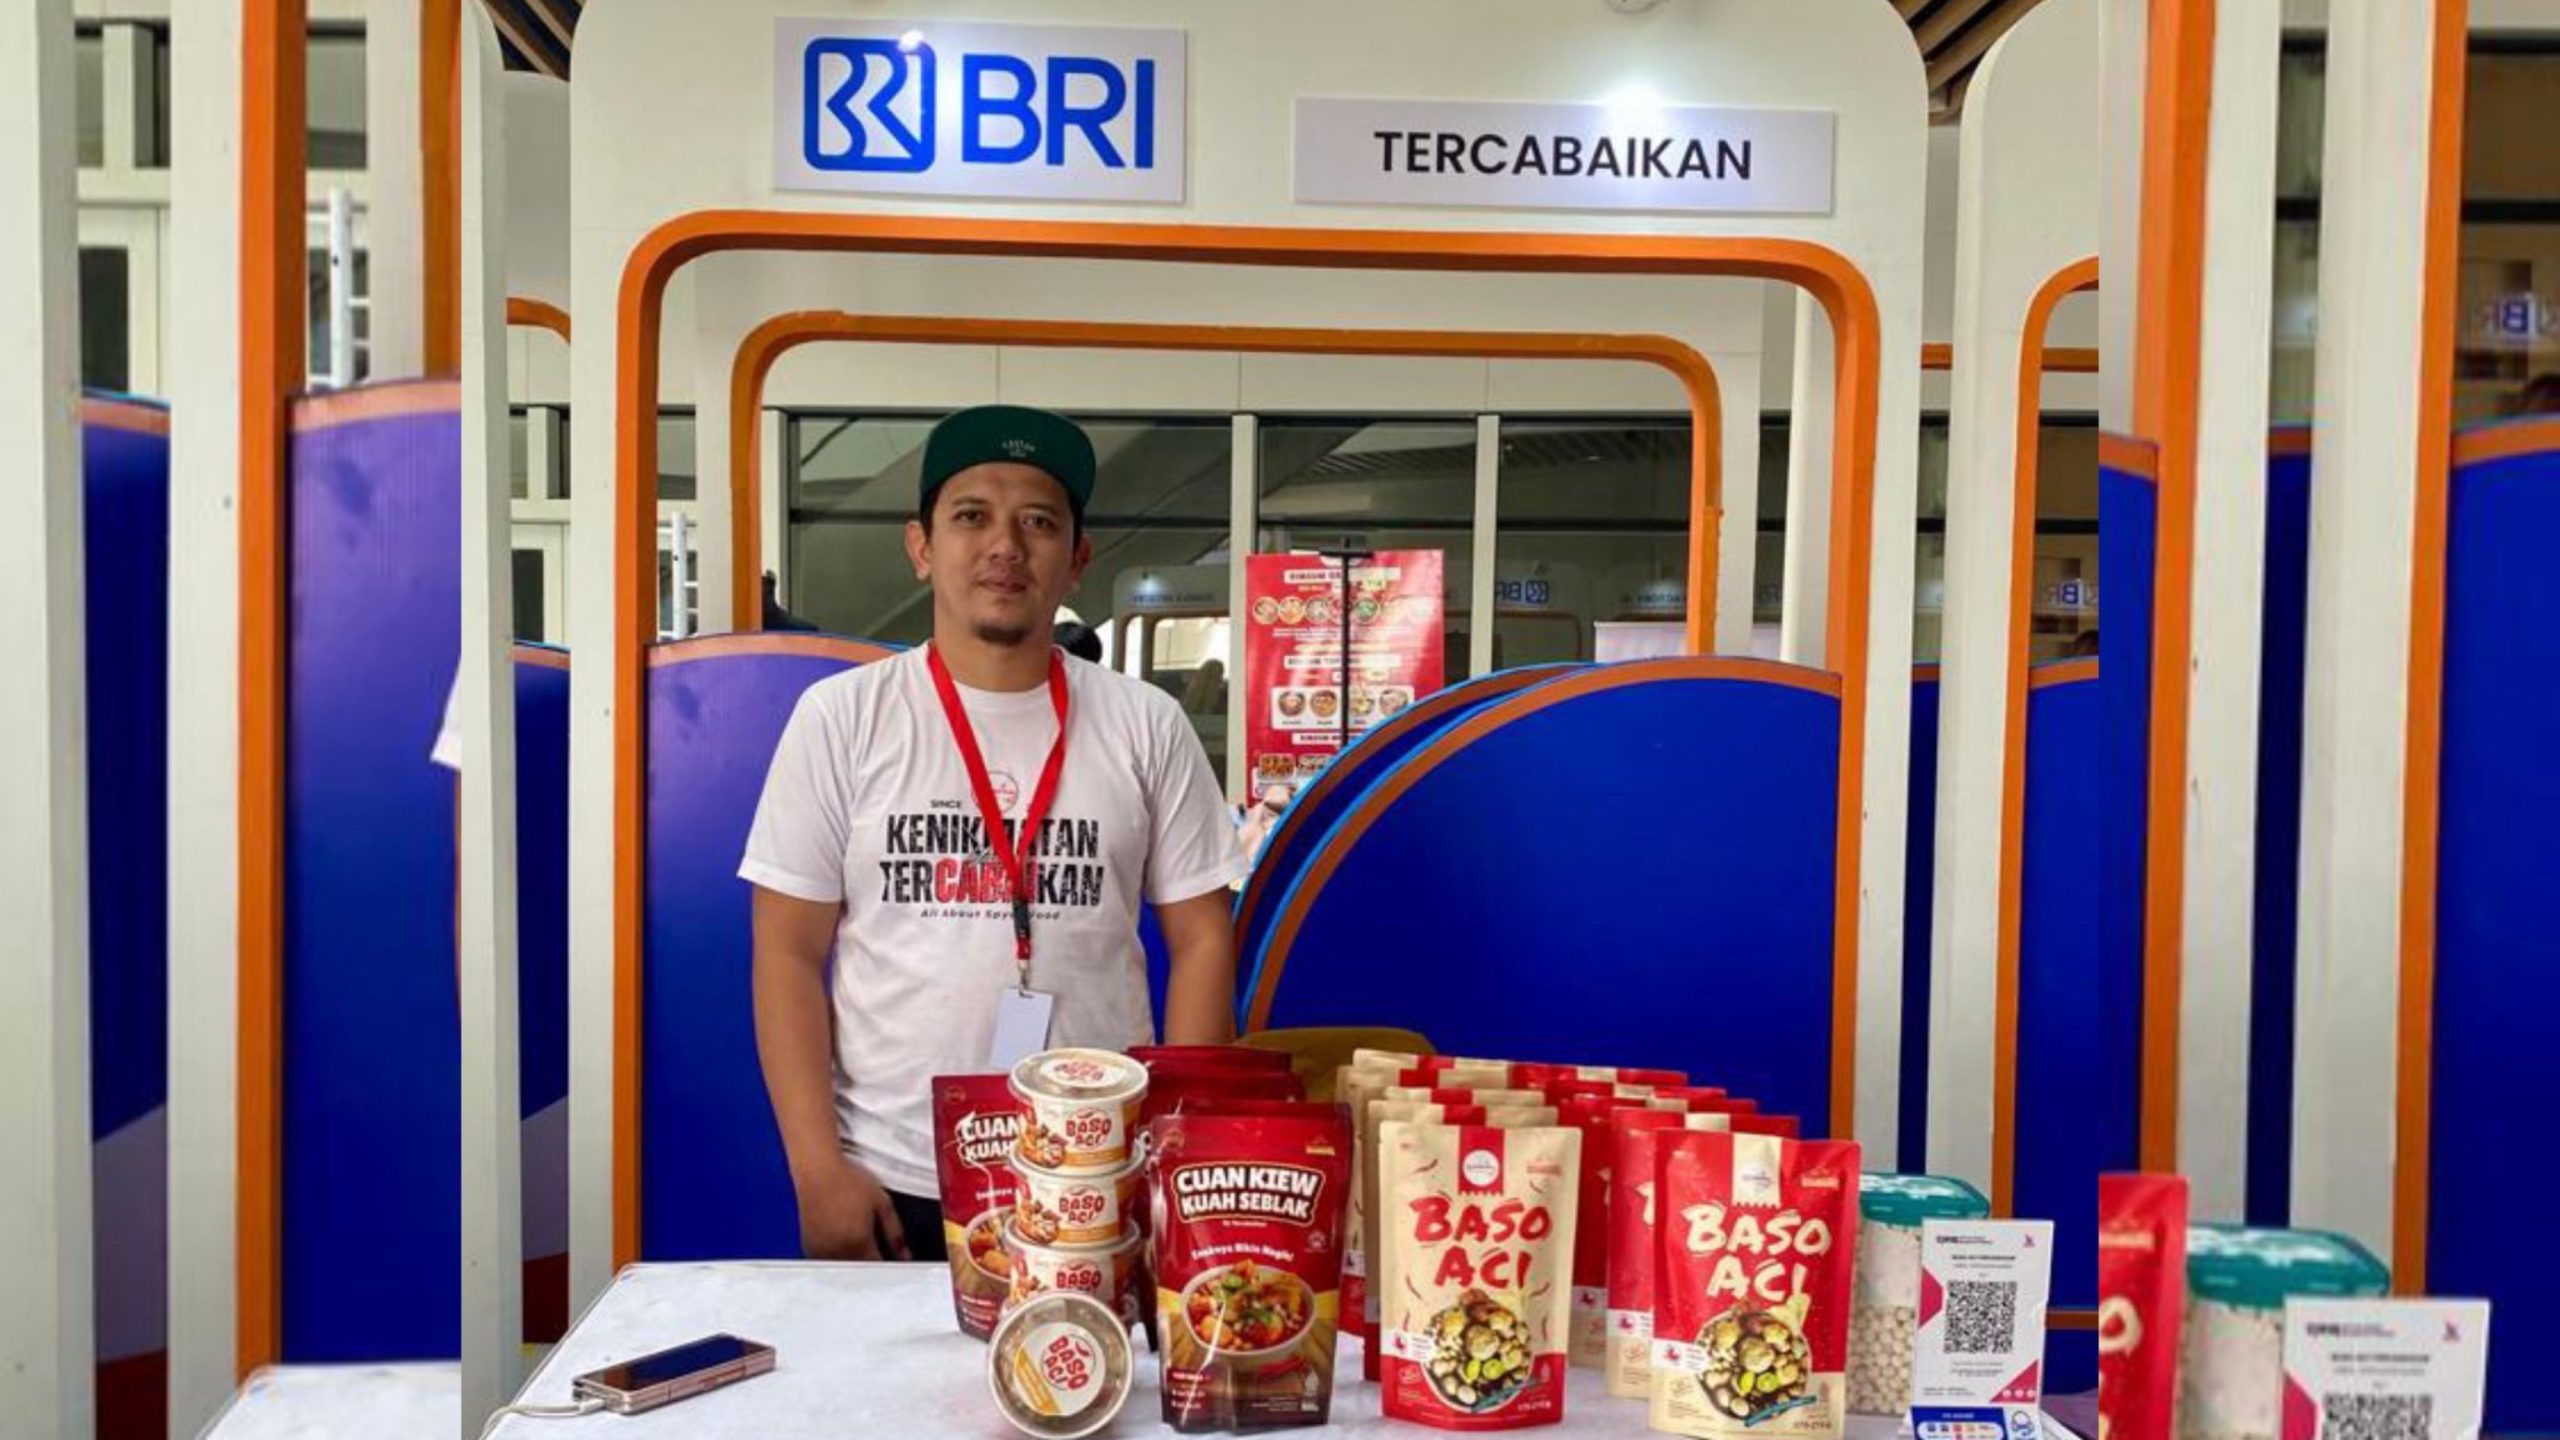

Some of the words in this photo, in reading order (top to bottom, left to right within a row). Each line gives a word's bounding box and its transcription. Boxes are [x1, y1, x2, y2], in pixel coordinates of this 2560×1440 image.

[962, 53, 1156, 169] BRI
[1374, 130, 1753, 181] TERCABAIKAN
[930, 800, 962, 809] SINCE
[887, 814, 1099, 858] KENIKTAN
[961, 1114, 1020, 1141] CUAN
[1066, 1118, 1112, 1137] BASO
[965, 1140, 1014, 1161] KUAH
[1177, 1166, 1246, 1193] CUAN
[1249, 1167, 1319, 1197] KIEW
[1059, 1194, 1105, 1213] BASO
[1181, 1192, 1236, 1216] KUAH
[1238, 1191, 1311, 1219] SEBLAK
[1408, 1196, 1553, 1243] BASO
[1681, 1200, 1833, 1258] BASO
[1056, 1270, 1102, 1289] BASO
[1434, 1245, 1533, 1290] ACI
[1706, 1255, 1808, 1302] ACI
[1048, 1335, 1090, 1391] BASO
